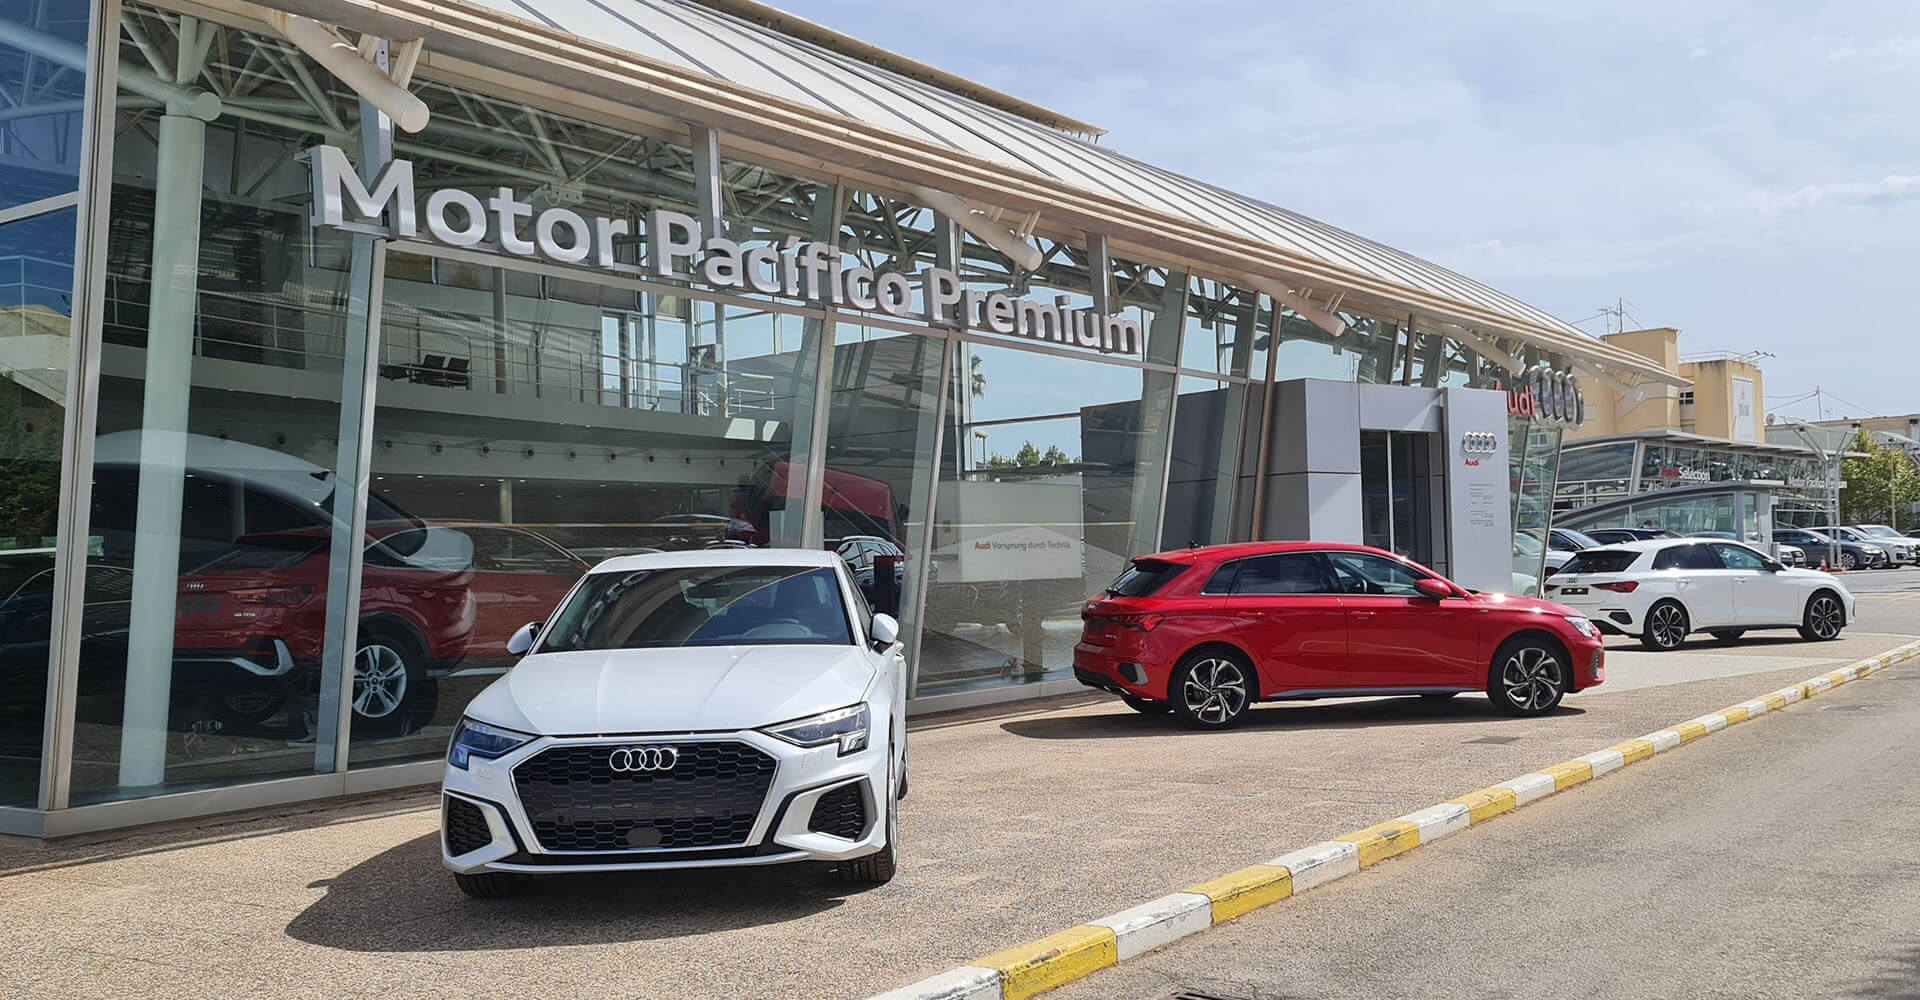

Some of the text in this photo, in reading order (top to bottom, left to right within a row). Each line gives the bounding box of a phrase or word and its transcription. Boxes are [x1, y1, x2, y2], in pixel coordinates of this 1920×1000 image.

[311, 145, 1142, 354] Motor Pacífico Premium
[1465, 458, 1480, 466] Audi
[975, 541, 991, 550] Audi
[992, 541, 1027, 551] Vorsprung
[1028, 541, 1046, 550] durch
